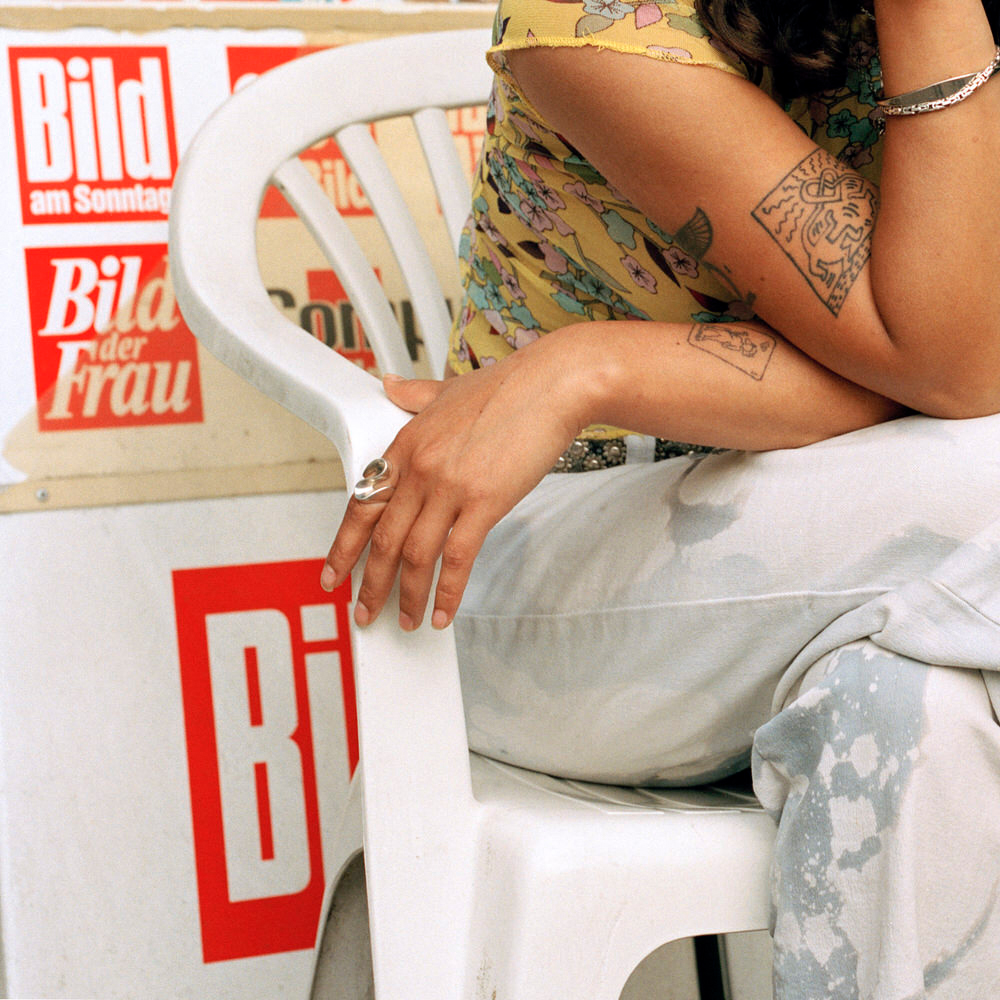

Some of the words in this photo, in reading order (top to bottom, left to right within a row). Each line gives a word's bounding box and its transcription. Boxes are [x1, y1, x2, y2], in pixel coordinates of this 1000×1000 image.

[17, 57, 172, 182] Bild
[29, 188, 72, 215] am
[73, 183, 172, 215] Sonntag
[38, 256, 180, 336] Bild
[44, 341, 192, 420] Frau
[98, 333, 148, 361] der
[204, 604, 354, 903] Bi
